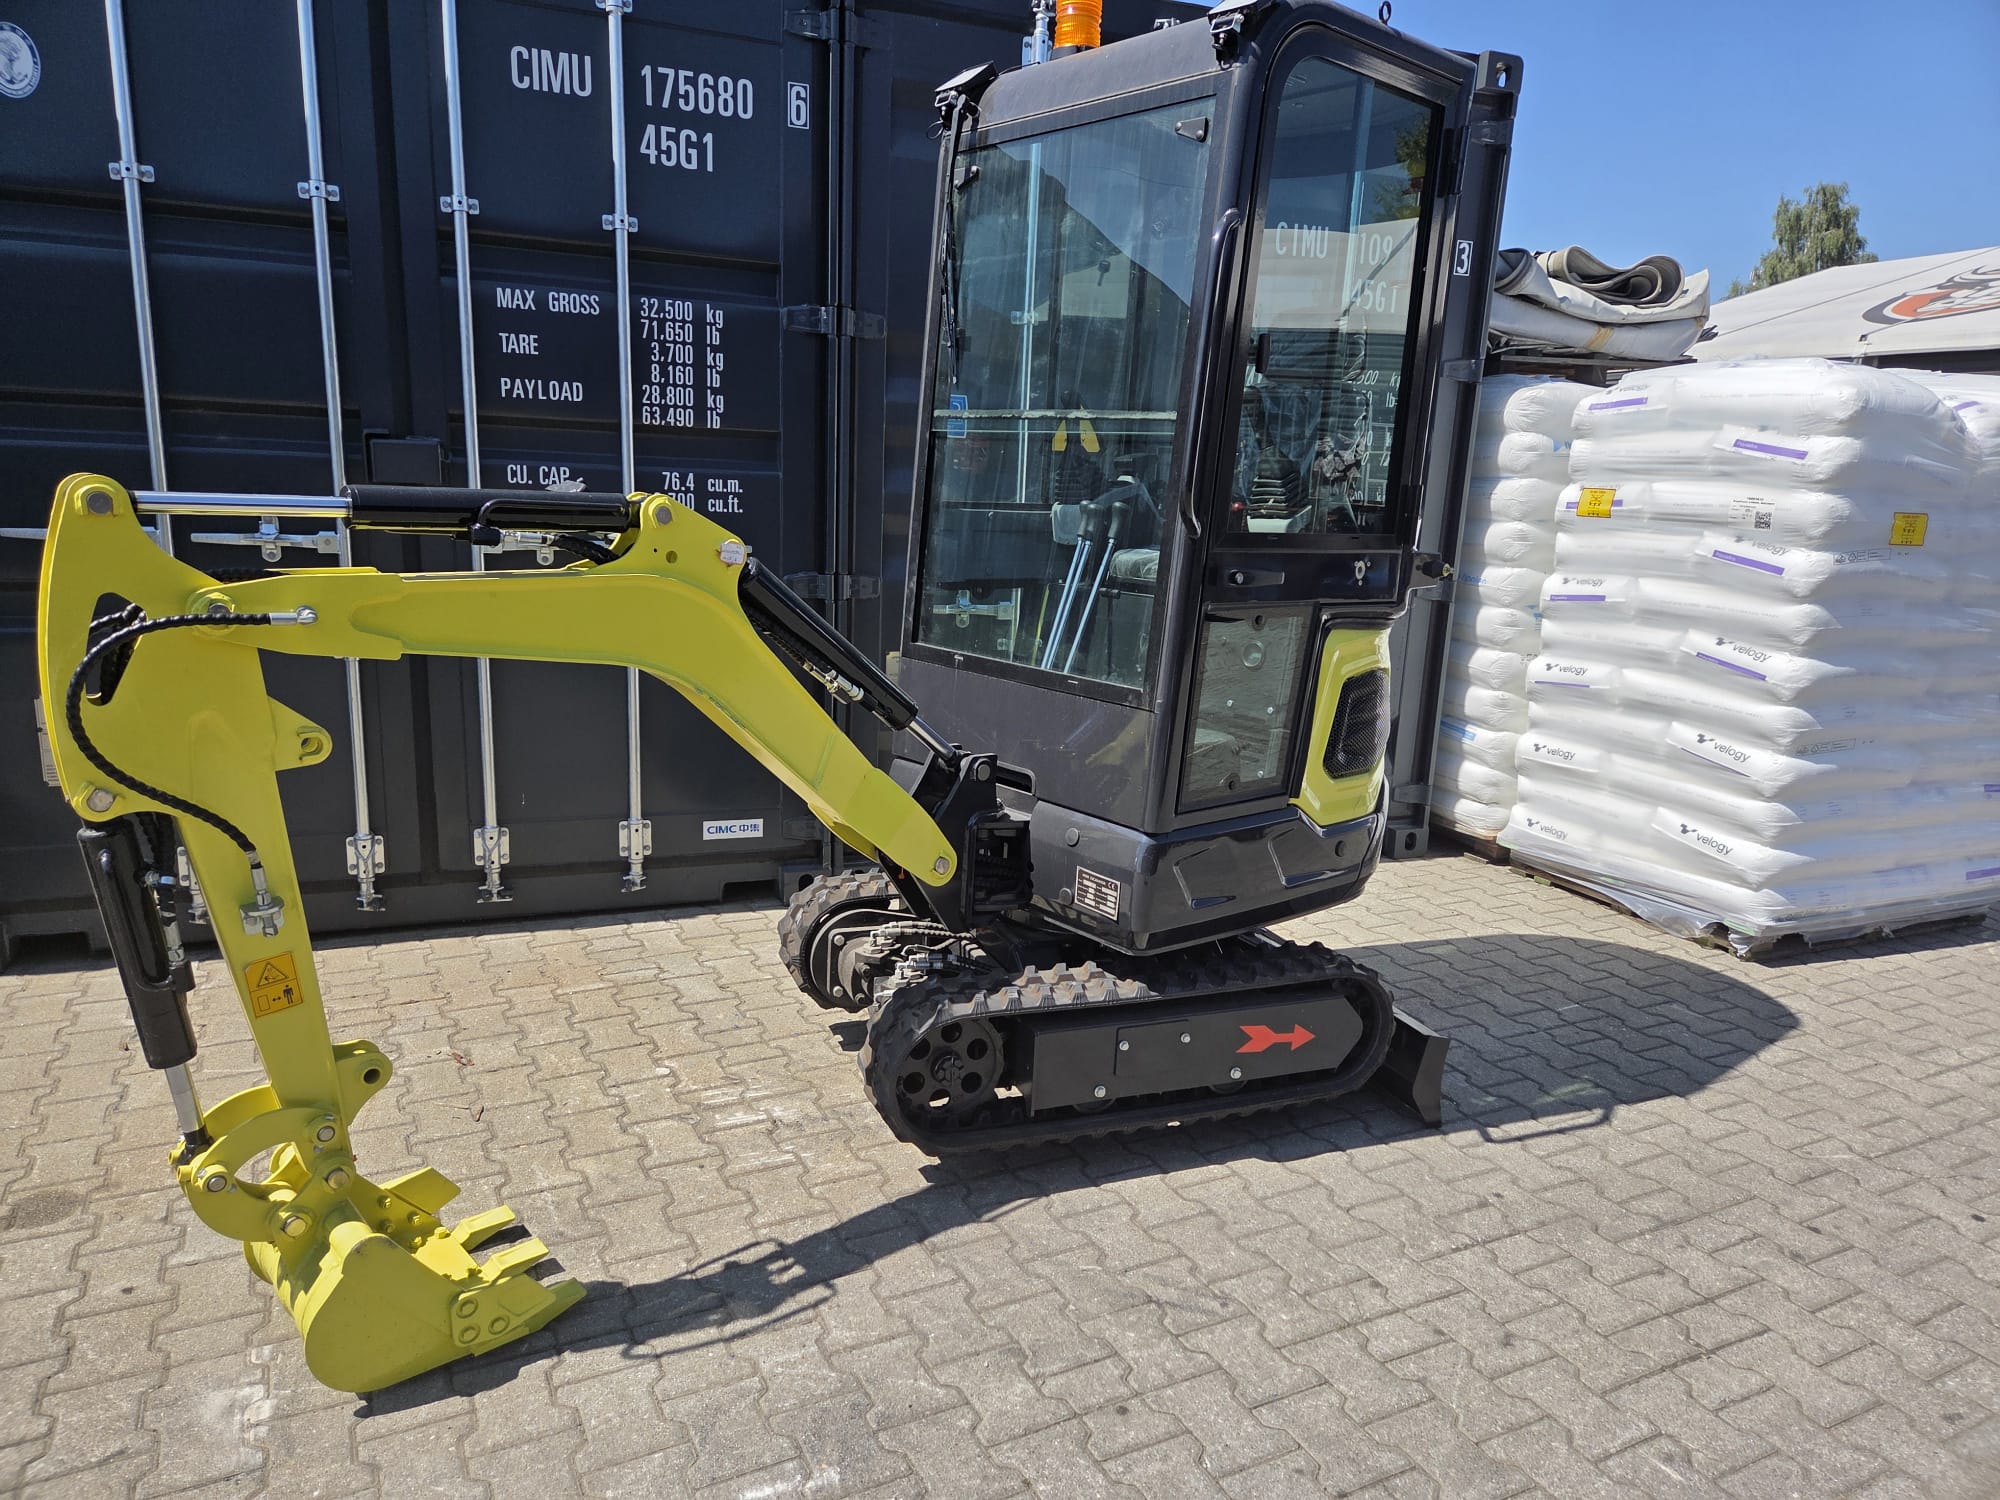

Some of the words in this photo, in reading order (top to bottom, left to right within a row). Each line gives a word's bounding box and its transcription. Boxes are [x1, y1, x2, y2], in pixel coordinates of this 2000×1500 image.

[510, 45, 592, 96] CIMU
[640, 64, 753, 120] 175680
[790, 85, 807, 126] 6
[639, 124, 714, 172] 45G1
[1275, 221, 1329, 260] CIMU
[1457, 242, 1470, 274] 3
[496, 287, 536, 311] MAX
[548, 291, 600, 316] GROSS
[640, 297, 693, 321] 32,500
[706, 303, 723, 329] kg
[1351, 278, 1399, 314] 45G1
[640, 319, 693, 343] 71,650
[706, 325, 720, 345] lb
[499, 332, 539, 355] TARE
[651, 342, 694, 364] 3,700
[706, 346, 724, 371] kg
[651, 363, 694, 385] 8,160
[707, 367, 720, 388] lb
[501, 377, 584, 402] PAYLOAD
[642, 384, 694, 406] 28,800
[707, 388, 724, 413] kg
[642, 406, 694, 428] 63,490
[707, 410, 720, 429] lb
[507, 463, 533, 485] CU.
[661, 471, 695, 491] 76.4
[707, 478, 744, 493] cu.m.
[707, 494, 744, 513] cu.ft.
[1733, 644, 1772, 663] velogy
[1559, 665, 1589, 676] velogy
[1546, 745, 1577, 761] velogy
[1713, 740, 1751, 764] velogy
[706, 824, 737, 835] CIMC
[1539, 823, 1569, 841] velogy
[1696, 831, 1734, 856] velogy
